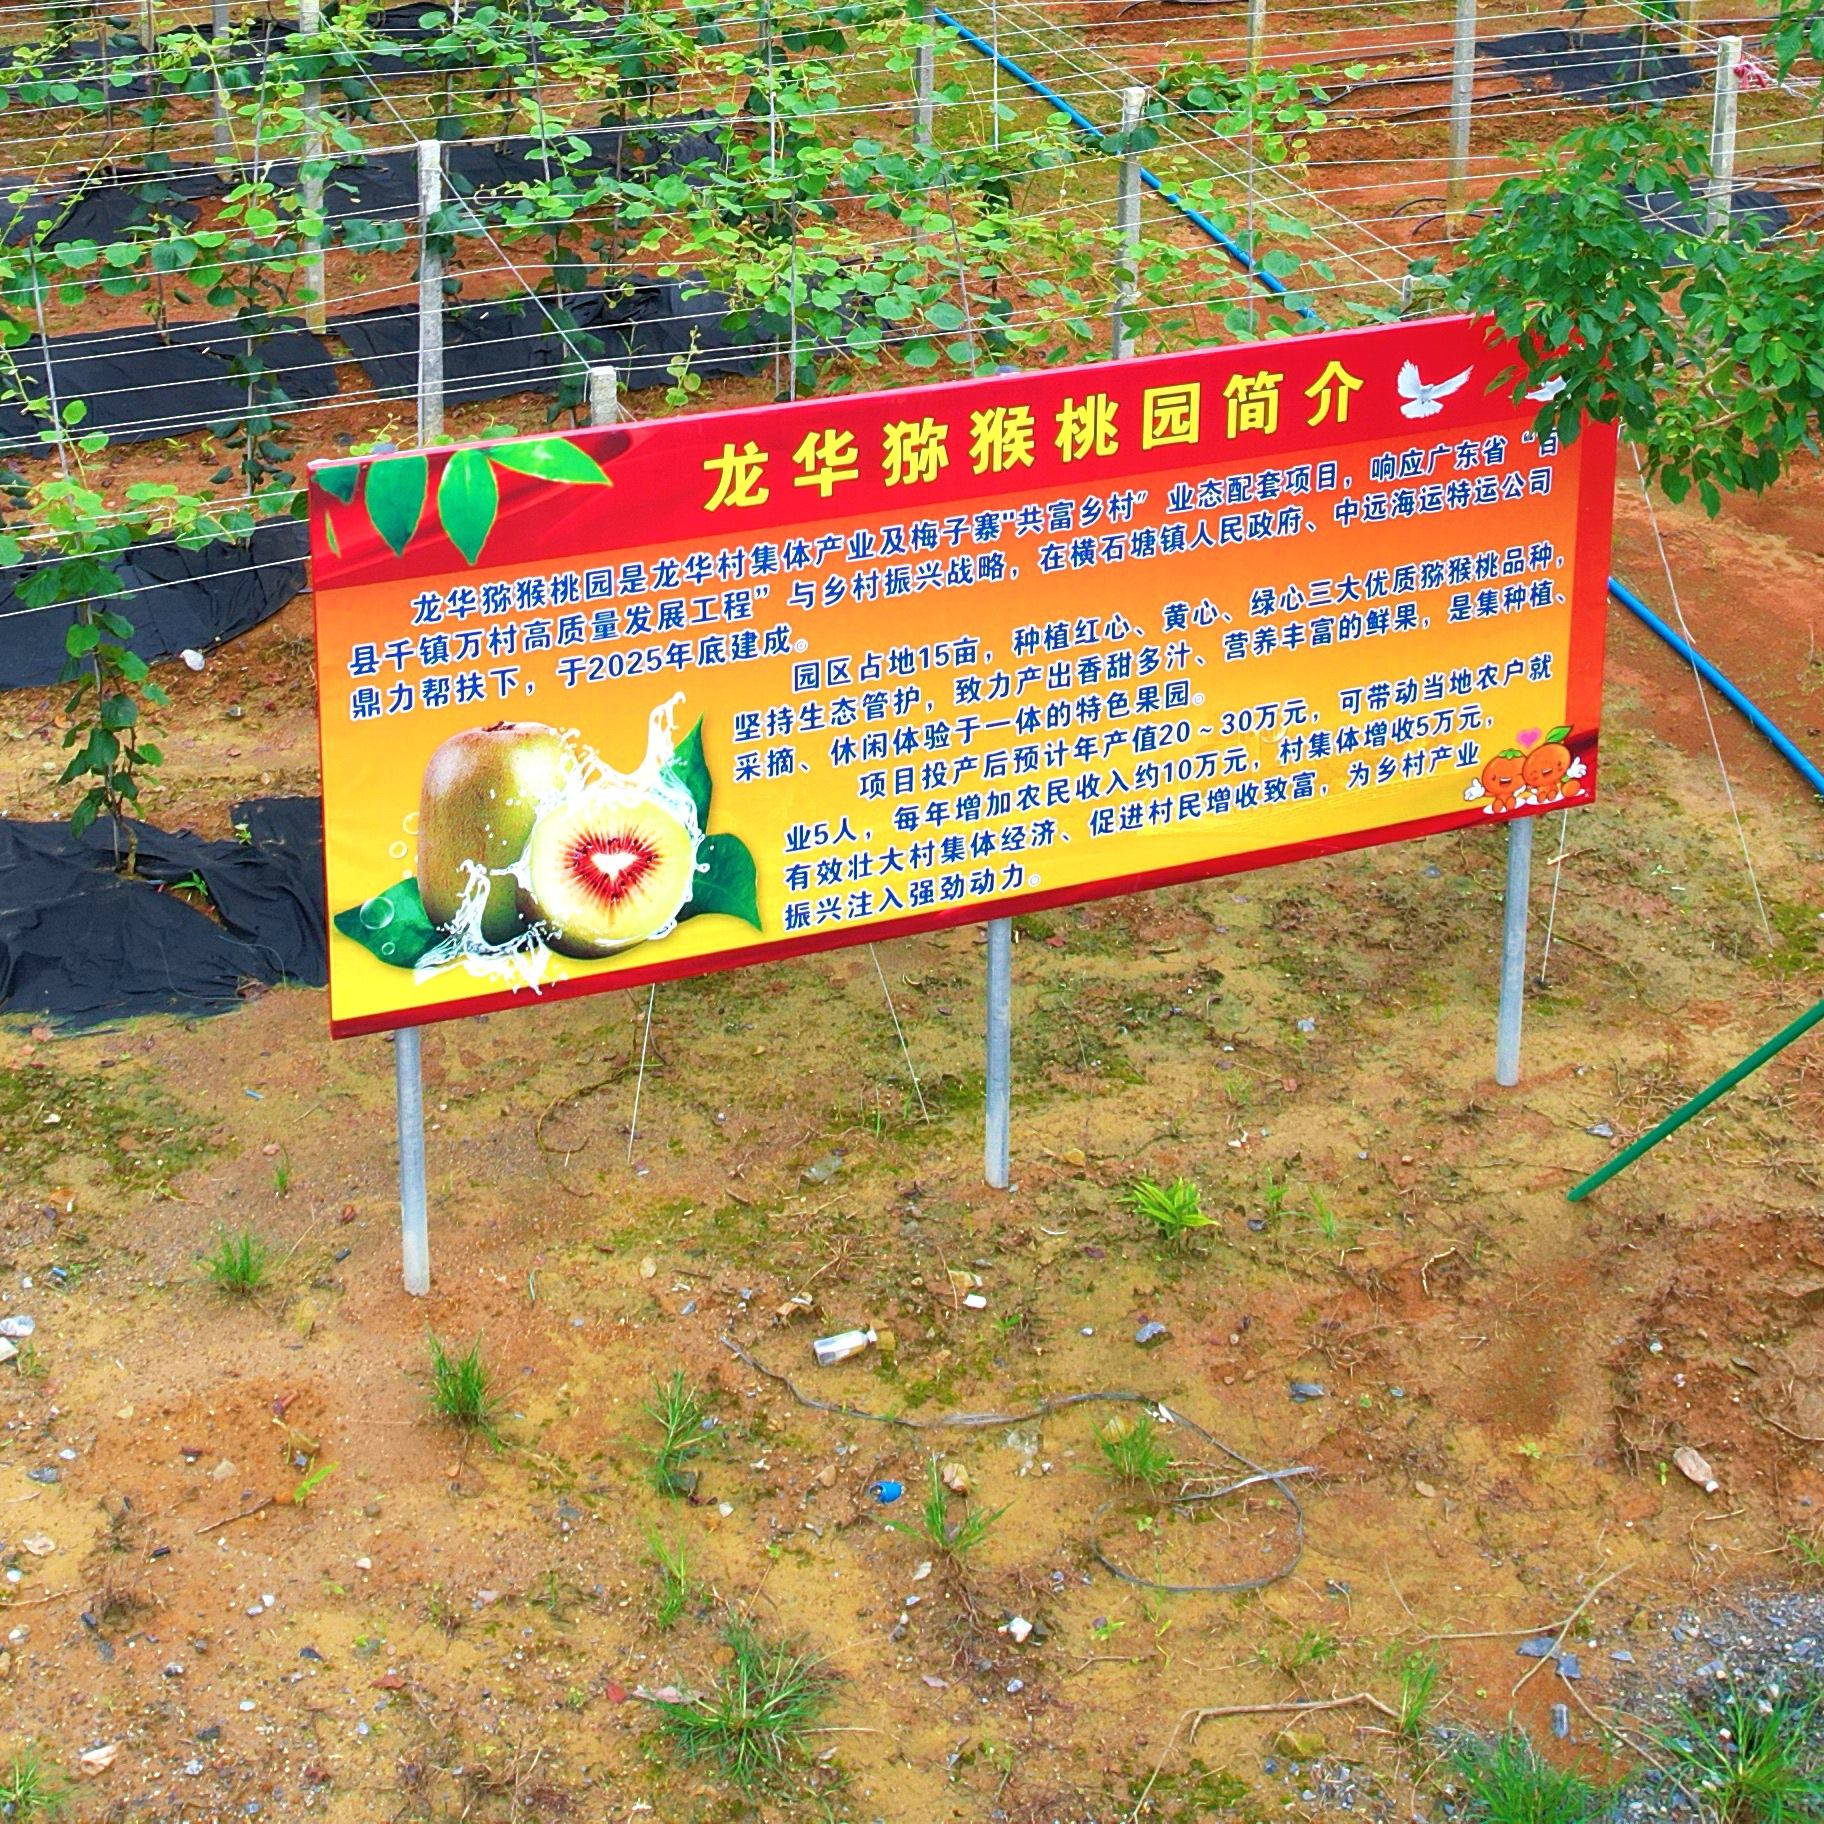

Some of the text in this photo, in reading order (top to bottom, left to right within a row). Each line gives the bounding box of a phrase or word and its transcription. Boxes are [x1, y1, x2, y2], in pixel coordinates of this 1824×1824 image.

[702, 360, 1366, 513] 龙华猕猴桃园简介
